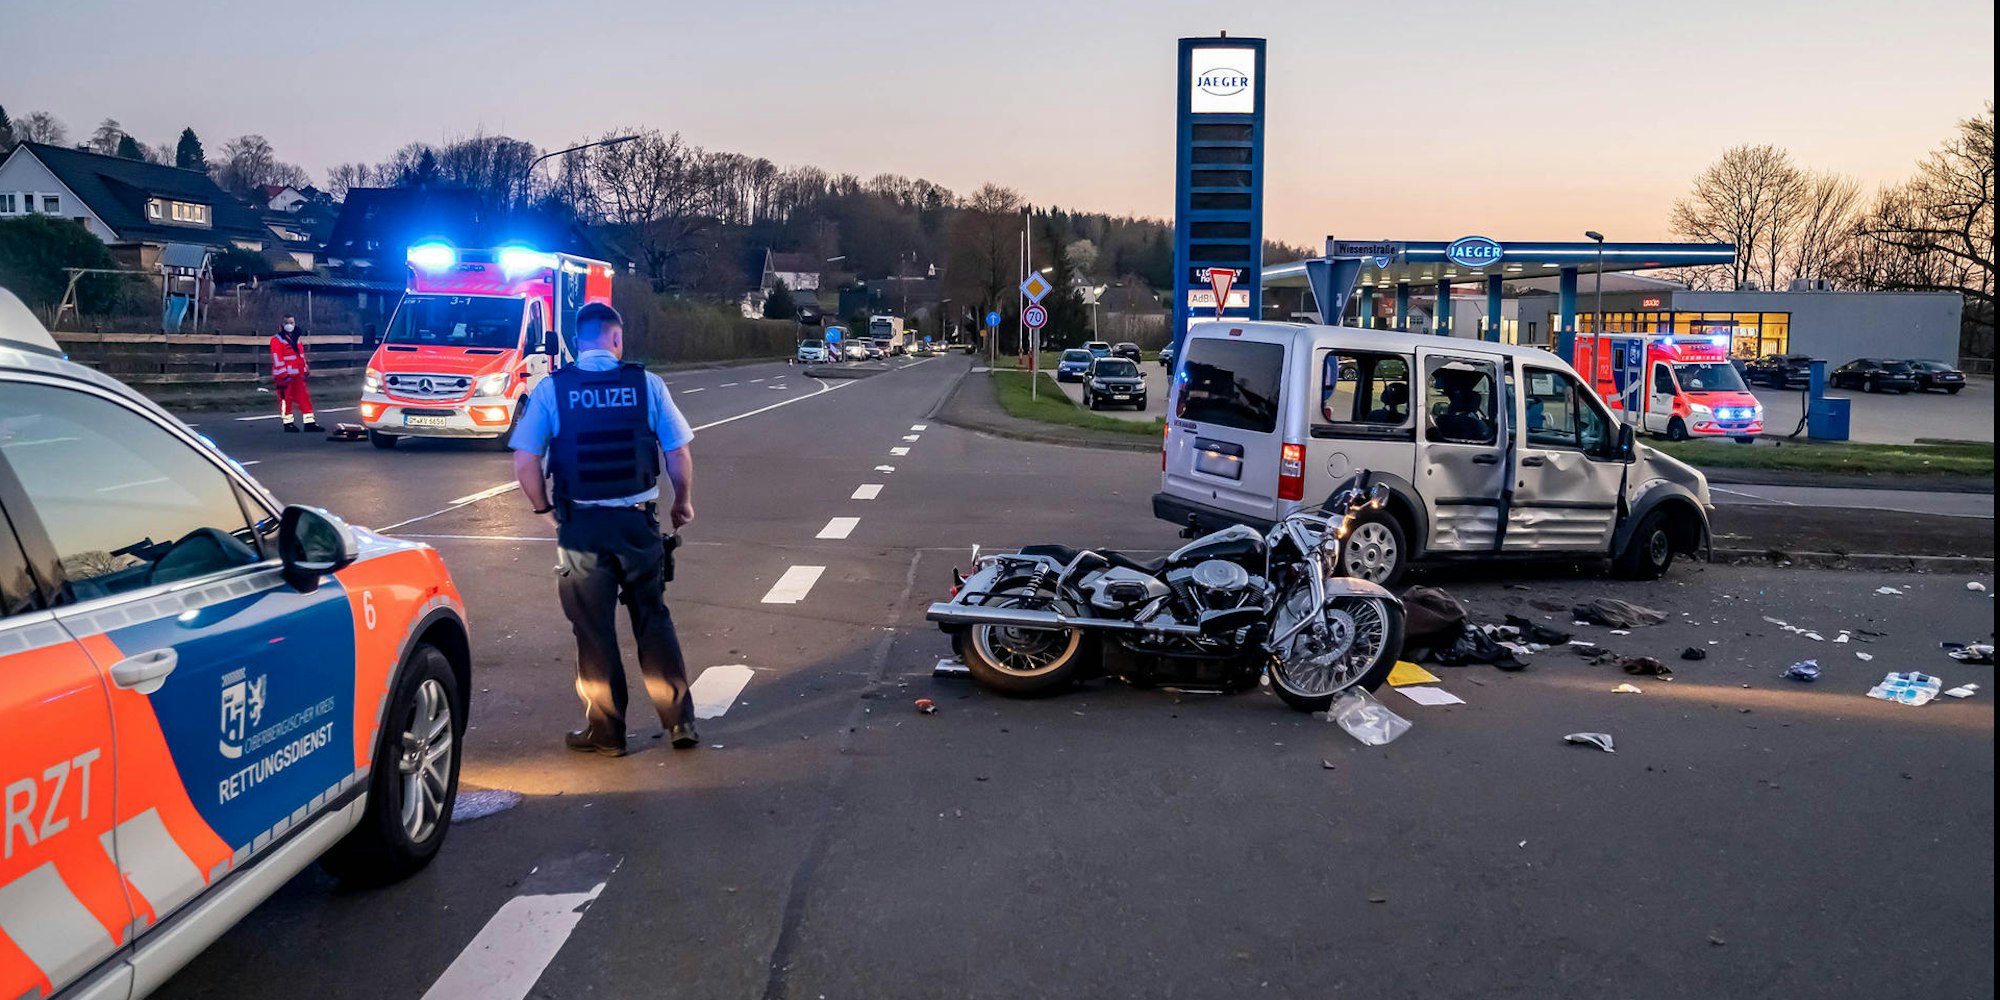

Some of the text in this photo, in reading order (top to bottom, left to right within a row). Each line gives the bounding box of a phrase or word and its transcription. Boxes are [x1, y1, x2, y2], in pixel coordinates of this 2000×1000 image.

[1197, 77, 1248, 87] JAEGER
[1339, 244, 1396, 254] Wiesenstraße
[1450, 247, 1501, 258] JAEGER
[450, 296, 472, 305] 3-1
[1029, 311, 1042, 323] 70
[569, 387, 638, 409] POLIZEI
[363, 590, 377, 630] 6
[244, 696, 336, 754] OBERBERGISCHER KREIS
[219, 721, 334, 805] RETTUNGSDIENST
